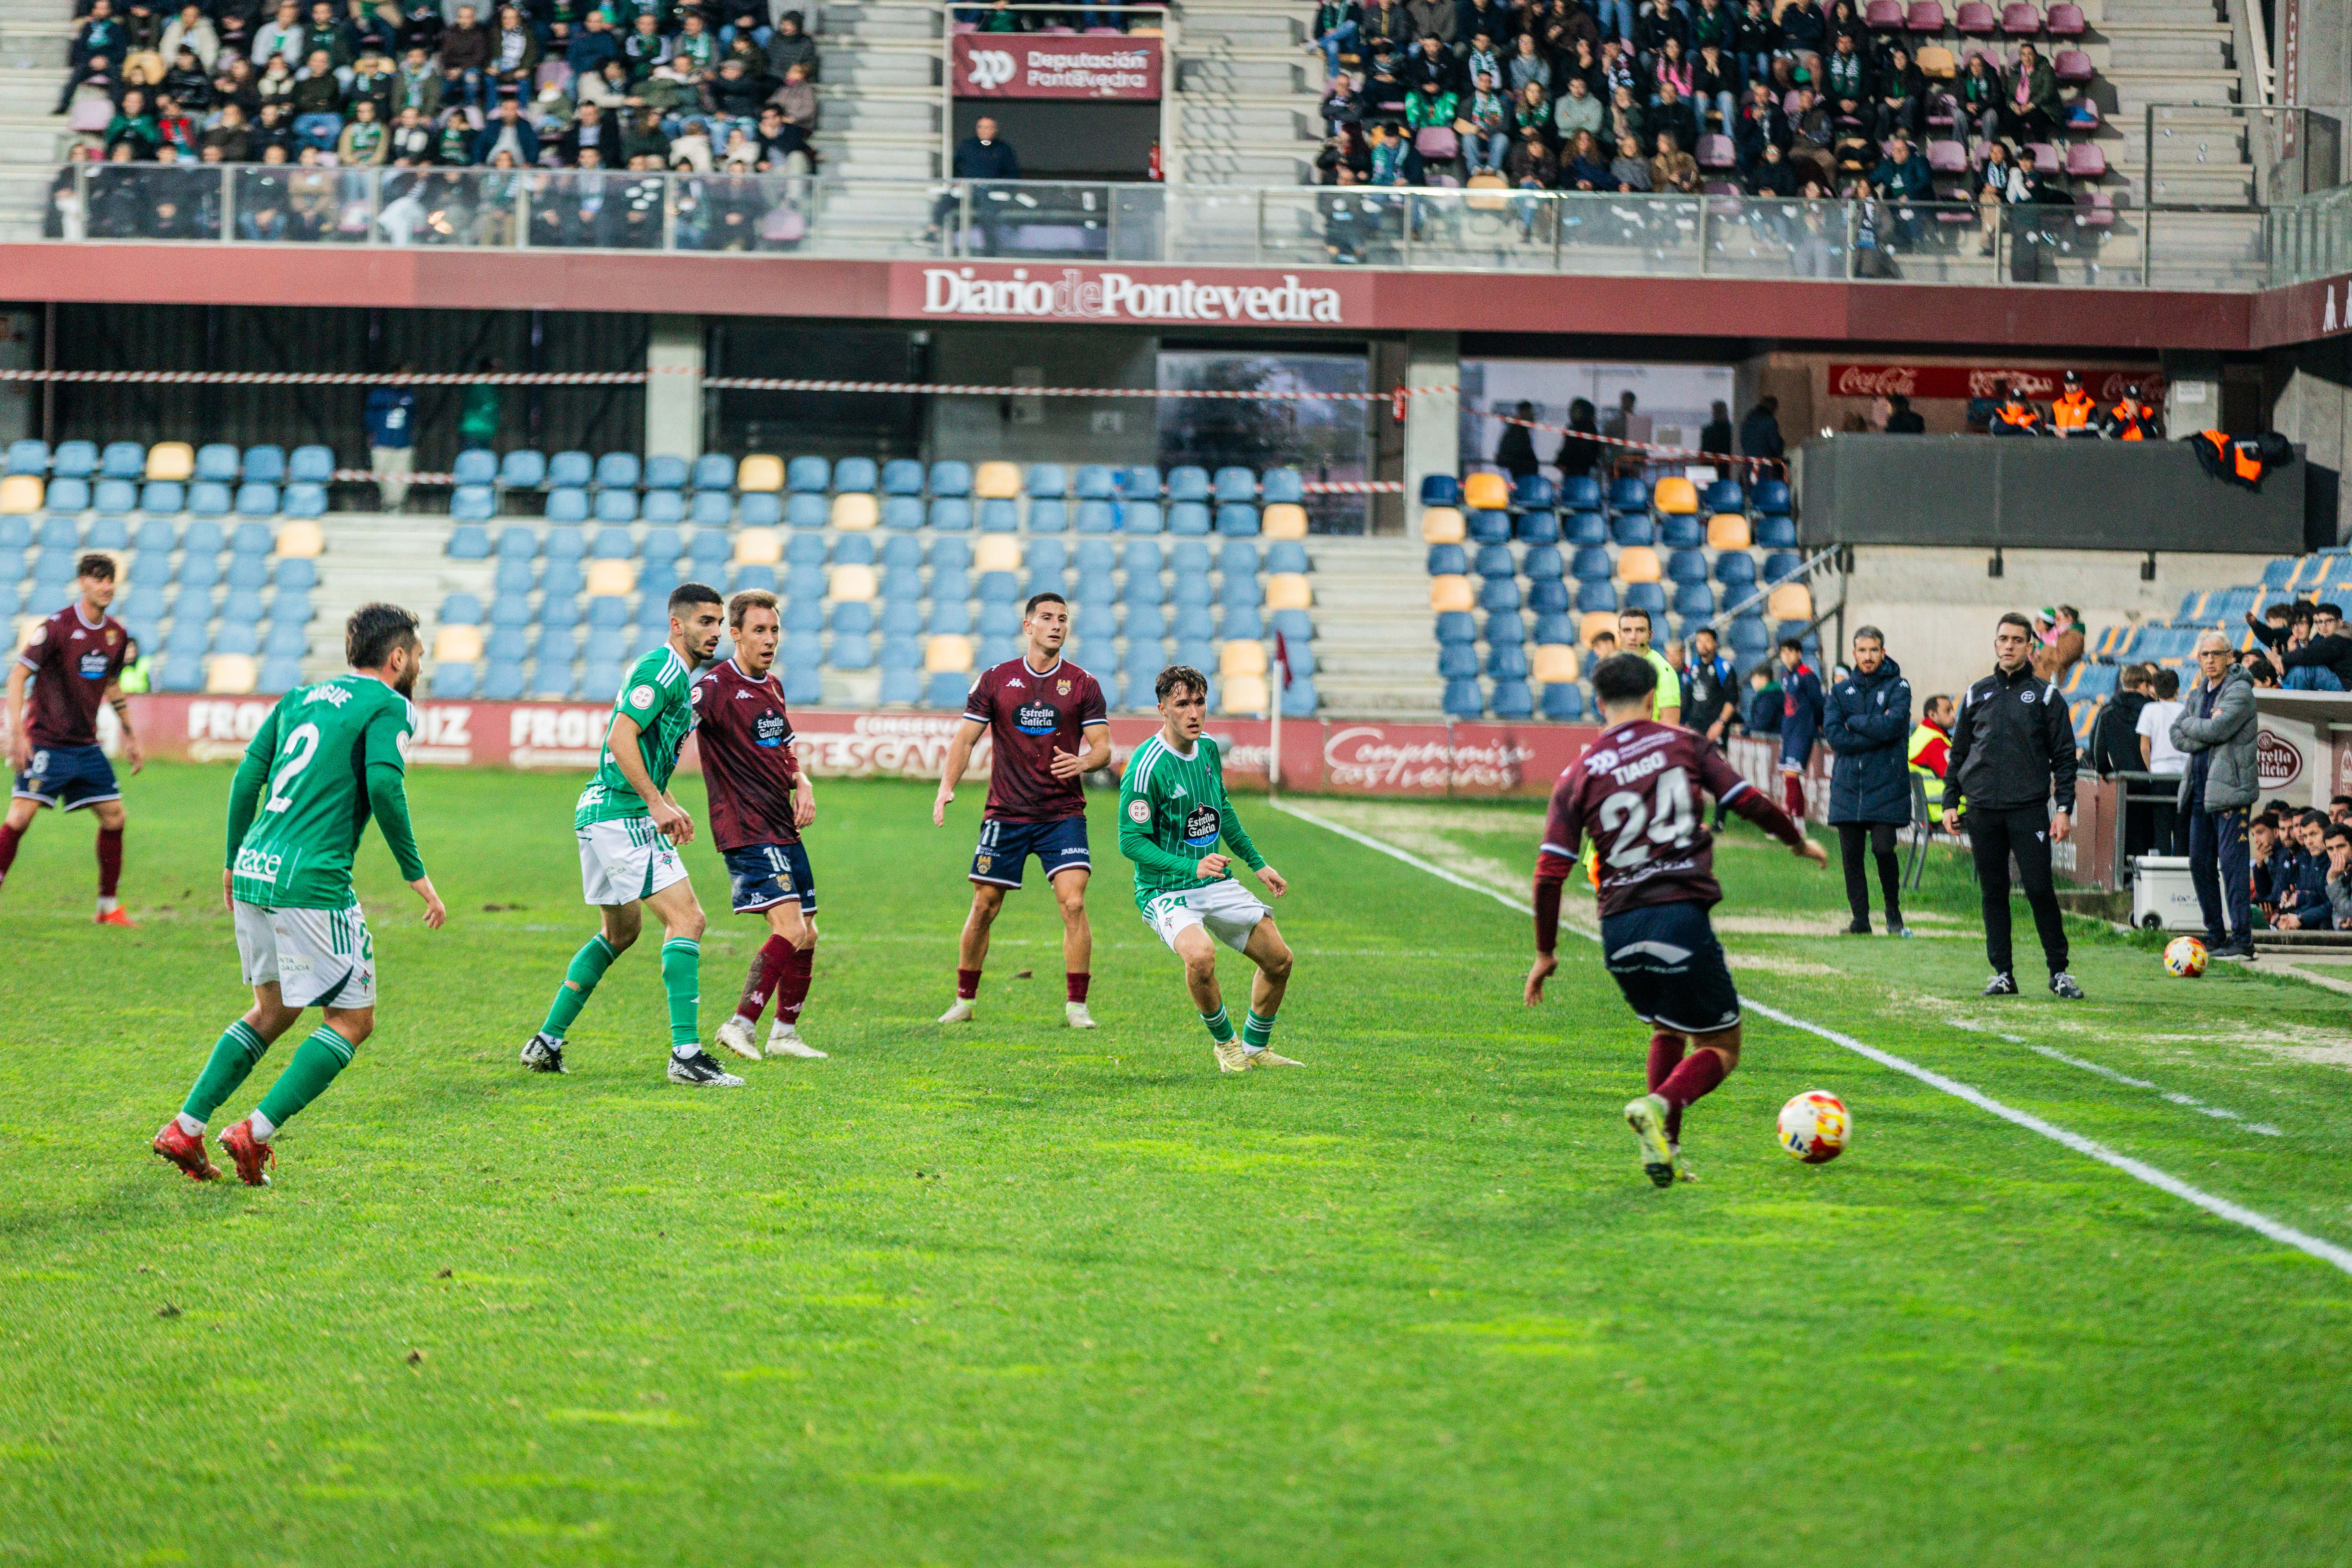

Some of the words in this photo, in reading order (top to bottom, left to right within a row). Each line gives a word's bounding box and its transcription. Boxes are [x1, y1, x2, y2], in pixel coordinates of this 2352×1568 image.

[1027, 50, 1147, 72] Deputación
[1027, 70, 1147, 87] Pontevedra
[923, 268, 1054, 315] Diario
[1100, 273, 1343, 322] Pontevedra
[757, 717, 784, 728] Estrella
[1020, 708, 1054, 717] Estrella
[1020, 716, 1052, 726] Galicia
[265, 722, 319, 813] 2
[1610, 751, 1667, 786] TIAGO
[1187, 813, 1215, 827] Estrella
[1599, 766, 1695, 868] 24
[981, 819, 1000, 847] 11
[1188, 823, 1216, 837] Galicia
[1159, 895, 1188, 915] 24
[360, 923, 372, 960] 2
